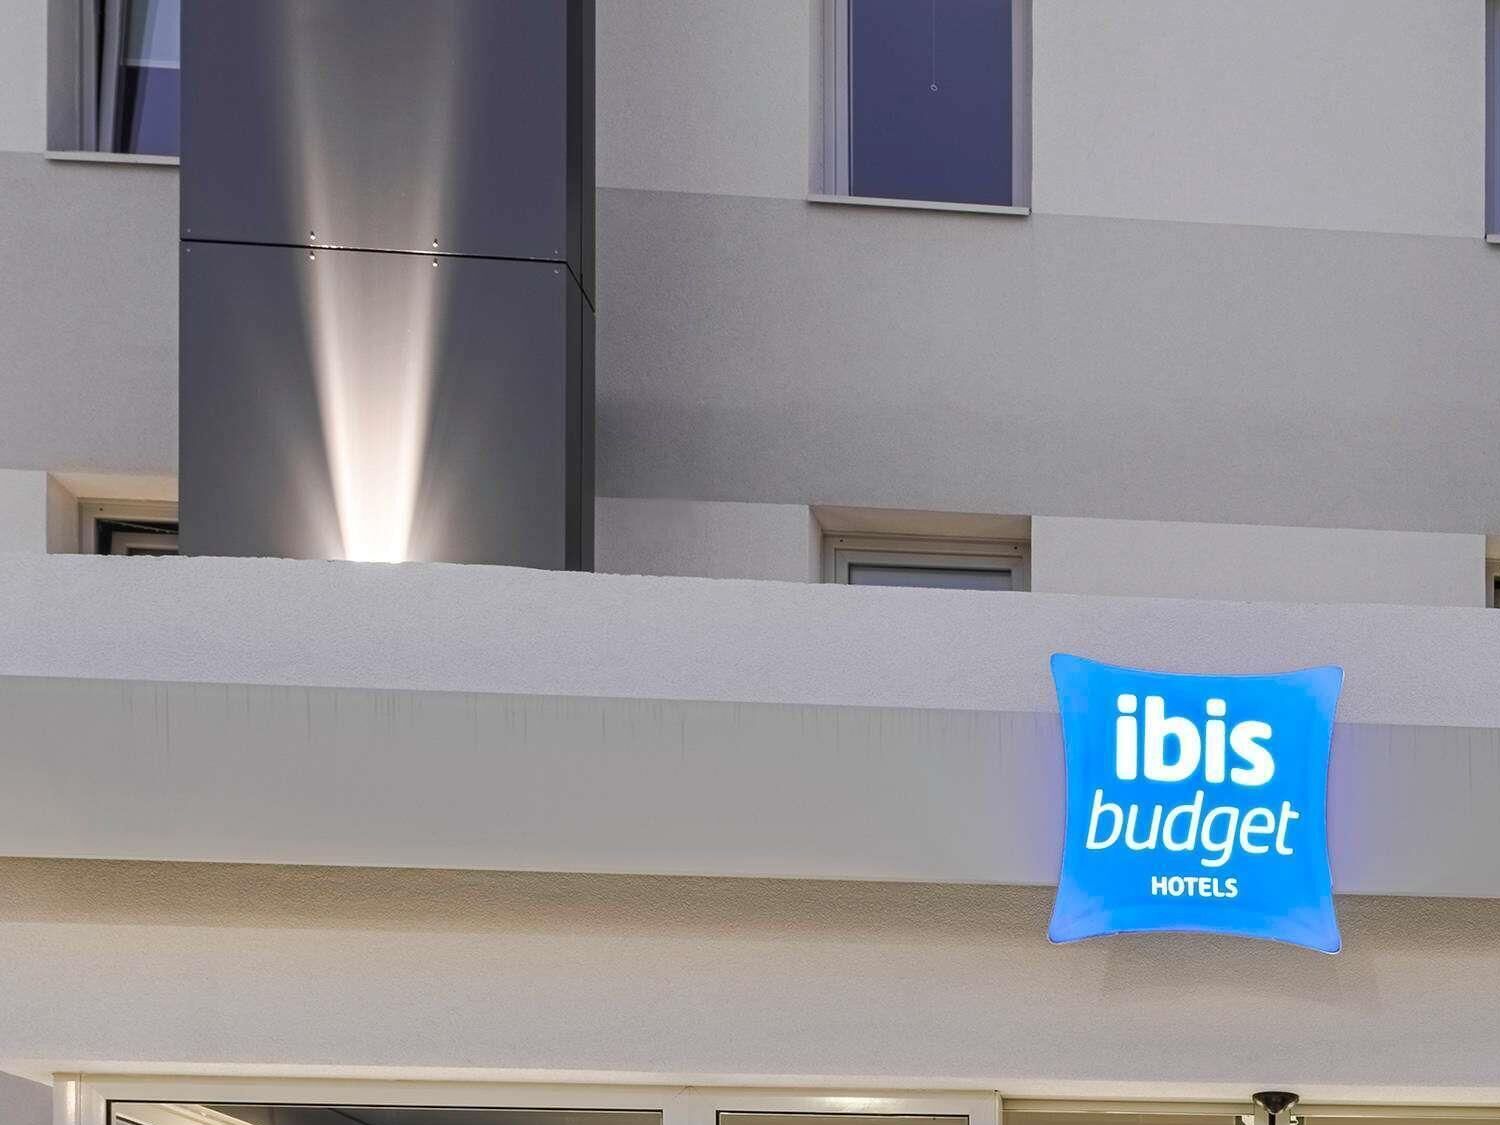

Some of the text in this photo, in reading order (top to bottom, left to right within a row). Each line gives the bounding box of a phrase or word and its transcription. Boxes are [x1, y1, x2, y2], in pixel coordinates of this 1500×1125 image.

[1115, 693, 1276, 787] ibis
[1085, 788, 1300, 868] budget
[1151, 875, 1239, 898] HOTELS
